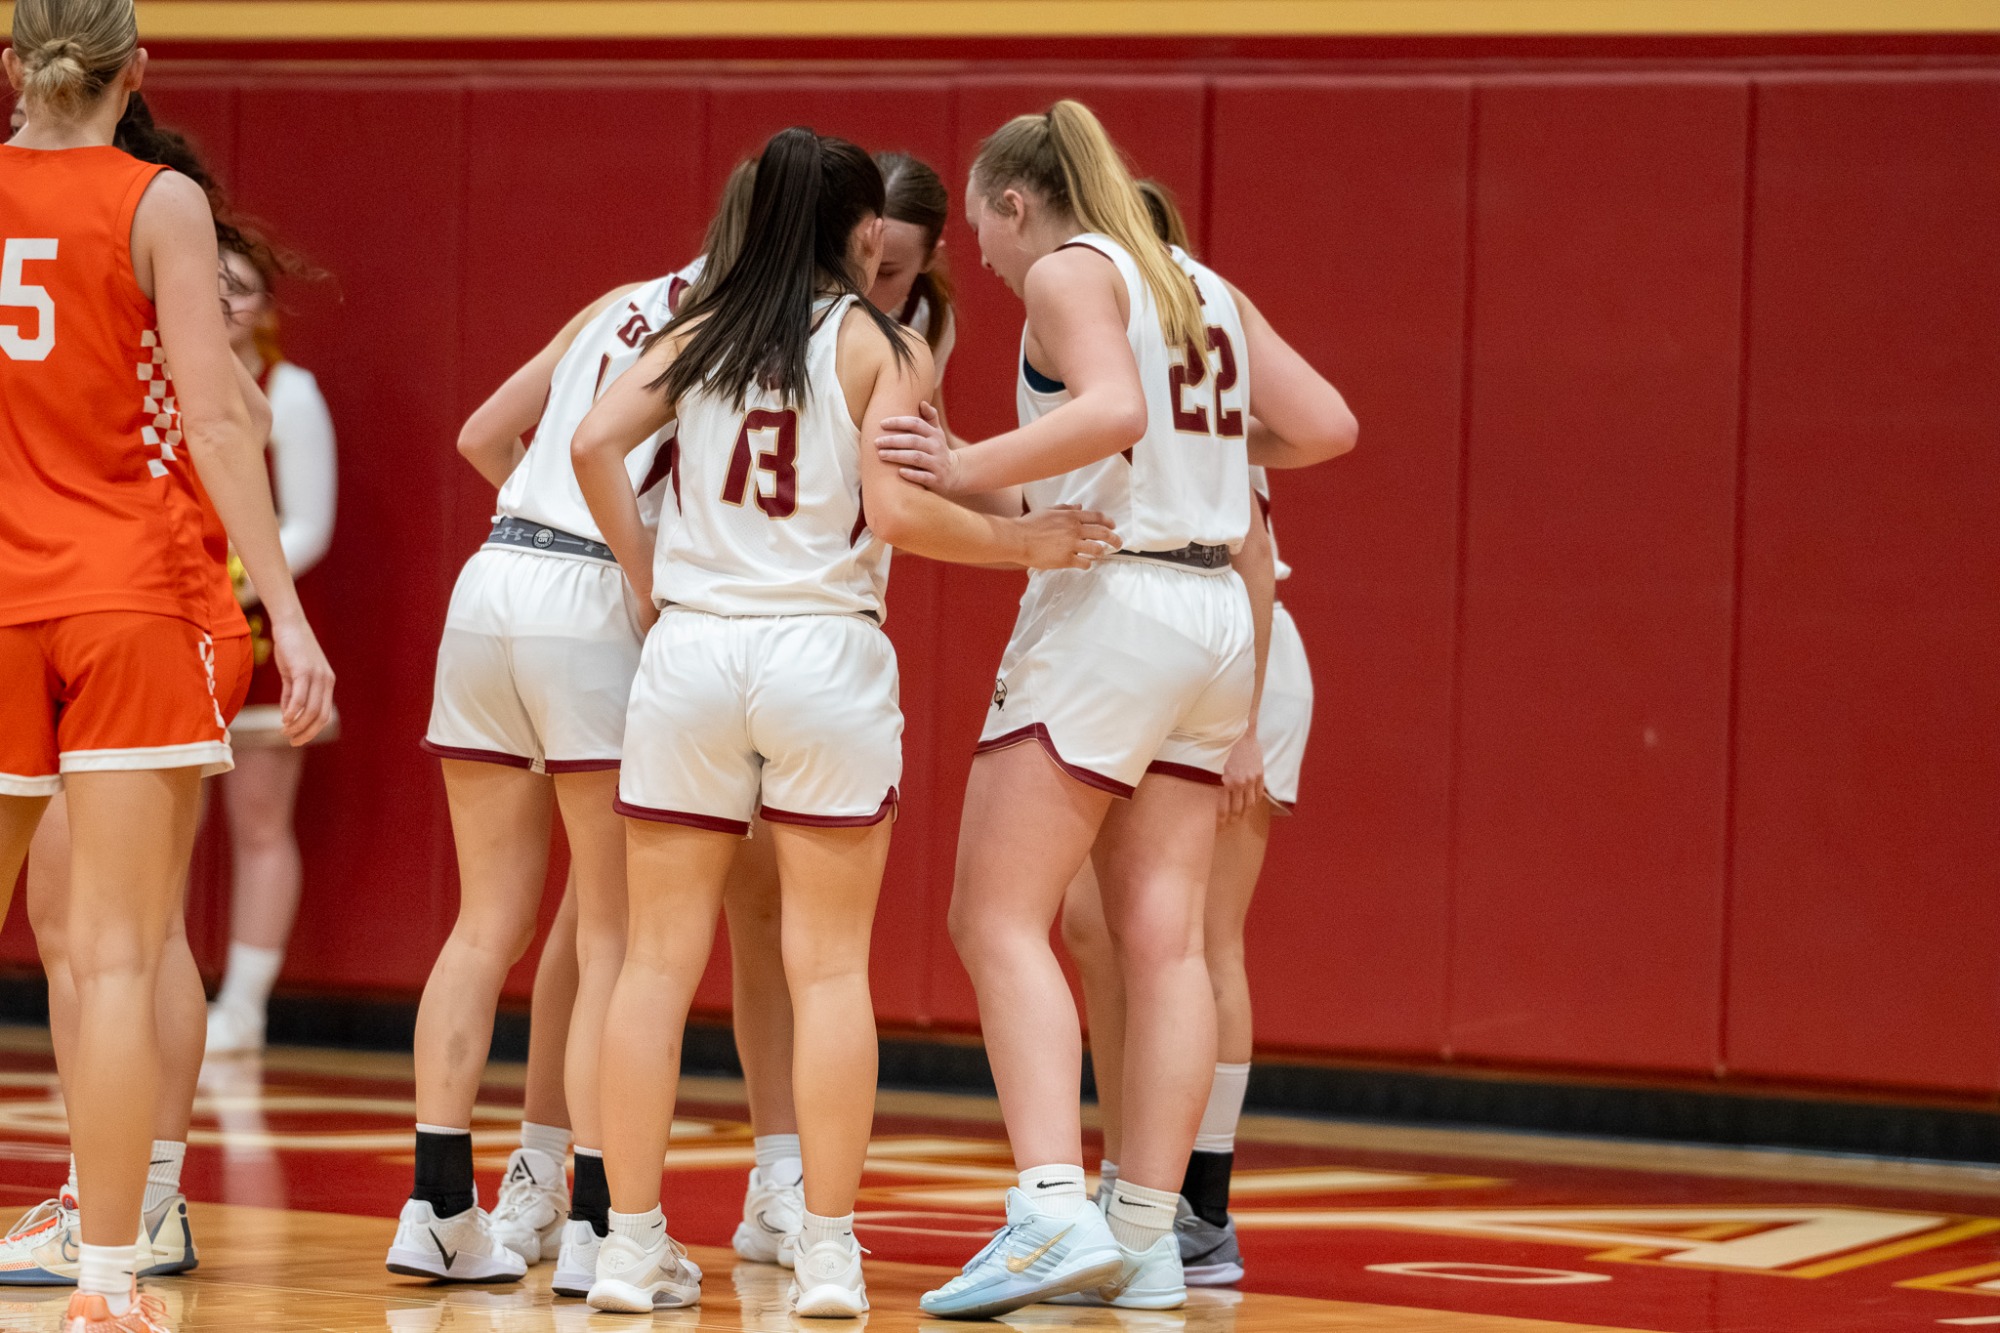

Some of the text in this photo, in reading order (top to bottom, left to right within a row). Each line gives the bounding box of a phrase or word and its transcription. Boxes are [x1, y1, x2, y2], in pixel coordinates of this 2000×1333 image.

[0, 238, 59, 361] 5
[1168, 323, 1245, 439] 22
[719, 406, 799, 520] 13
